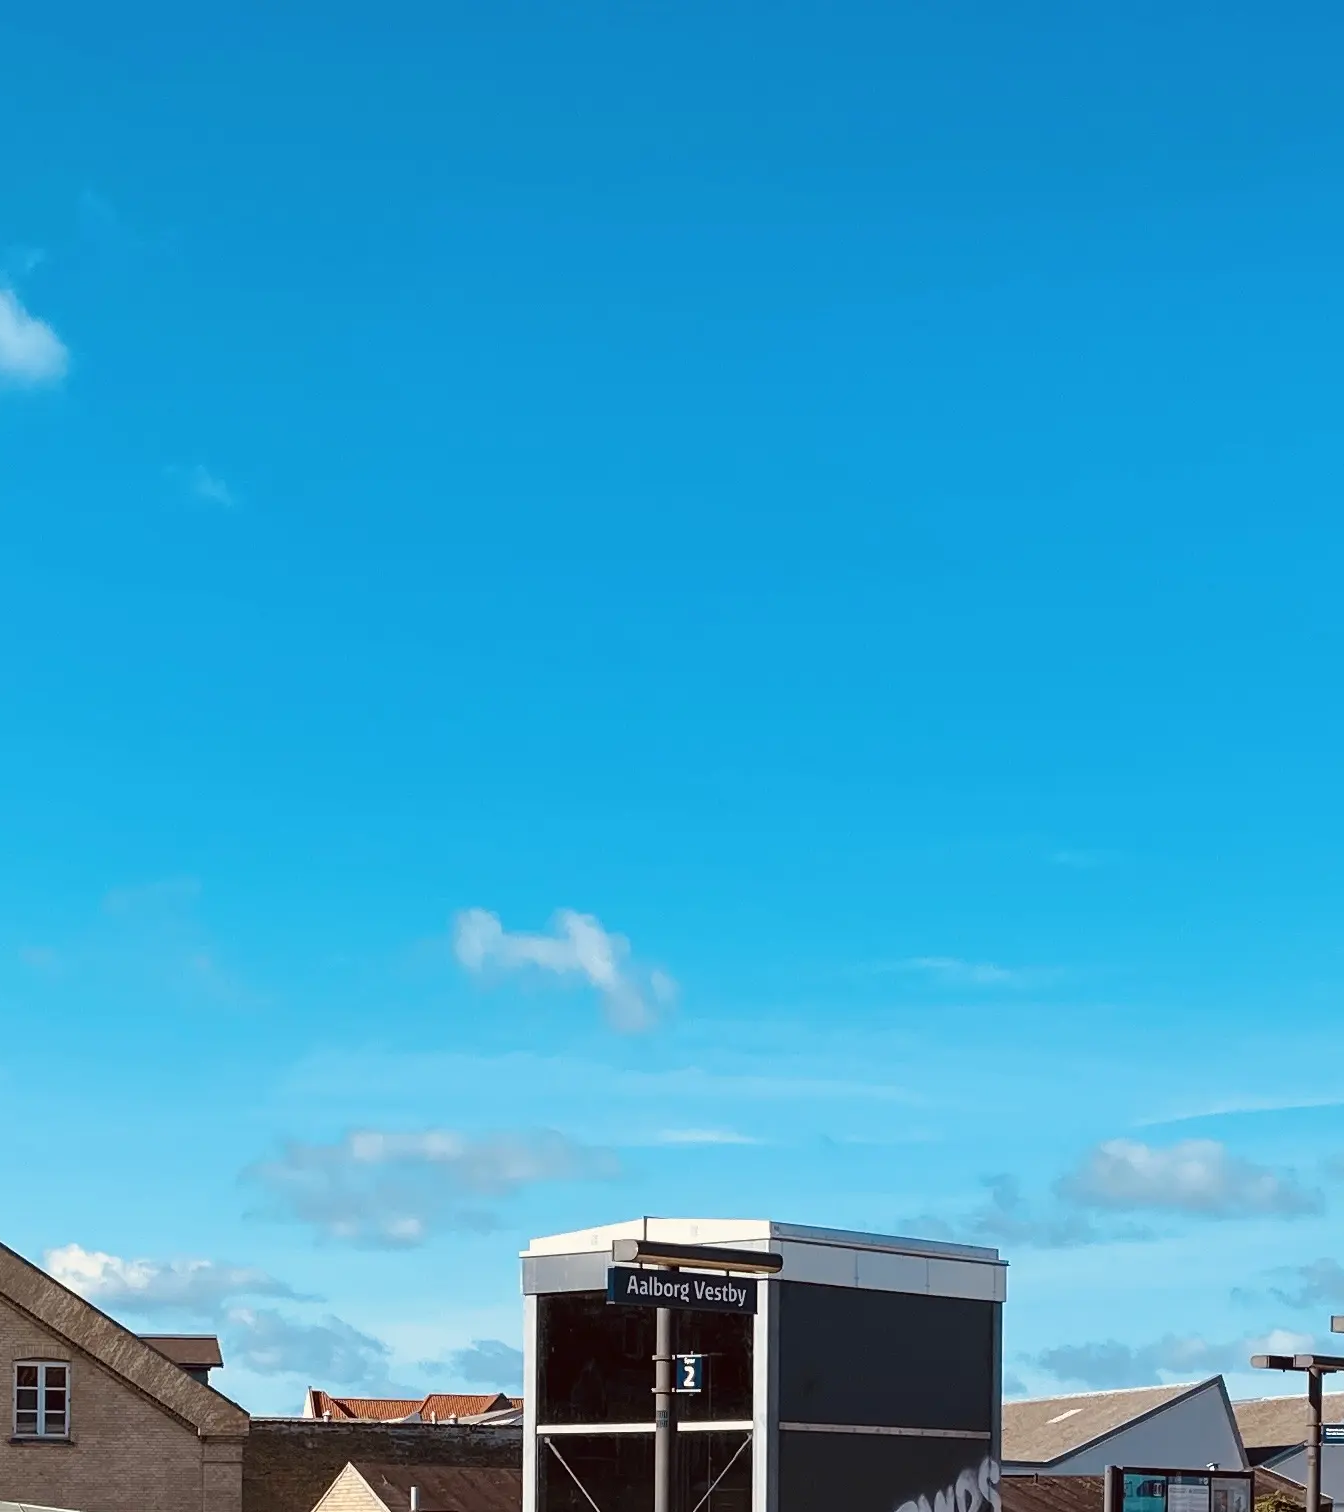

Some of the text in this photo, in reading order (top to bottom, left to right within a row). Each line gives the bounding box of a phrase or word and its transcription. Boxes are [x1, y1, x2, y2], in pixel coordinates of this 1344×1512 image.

[626, 1275, 747, 1307] Aalborg Vestby
[683, 1365, 695, 1387] 2
